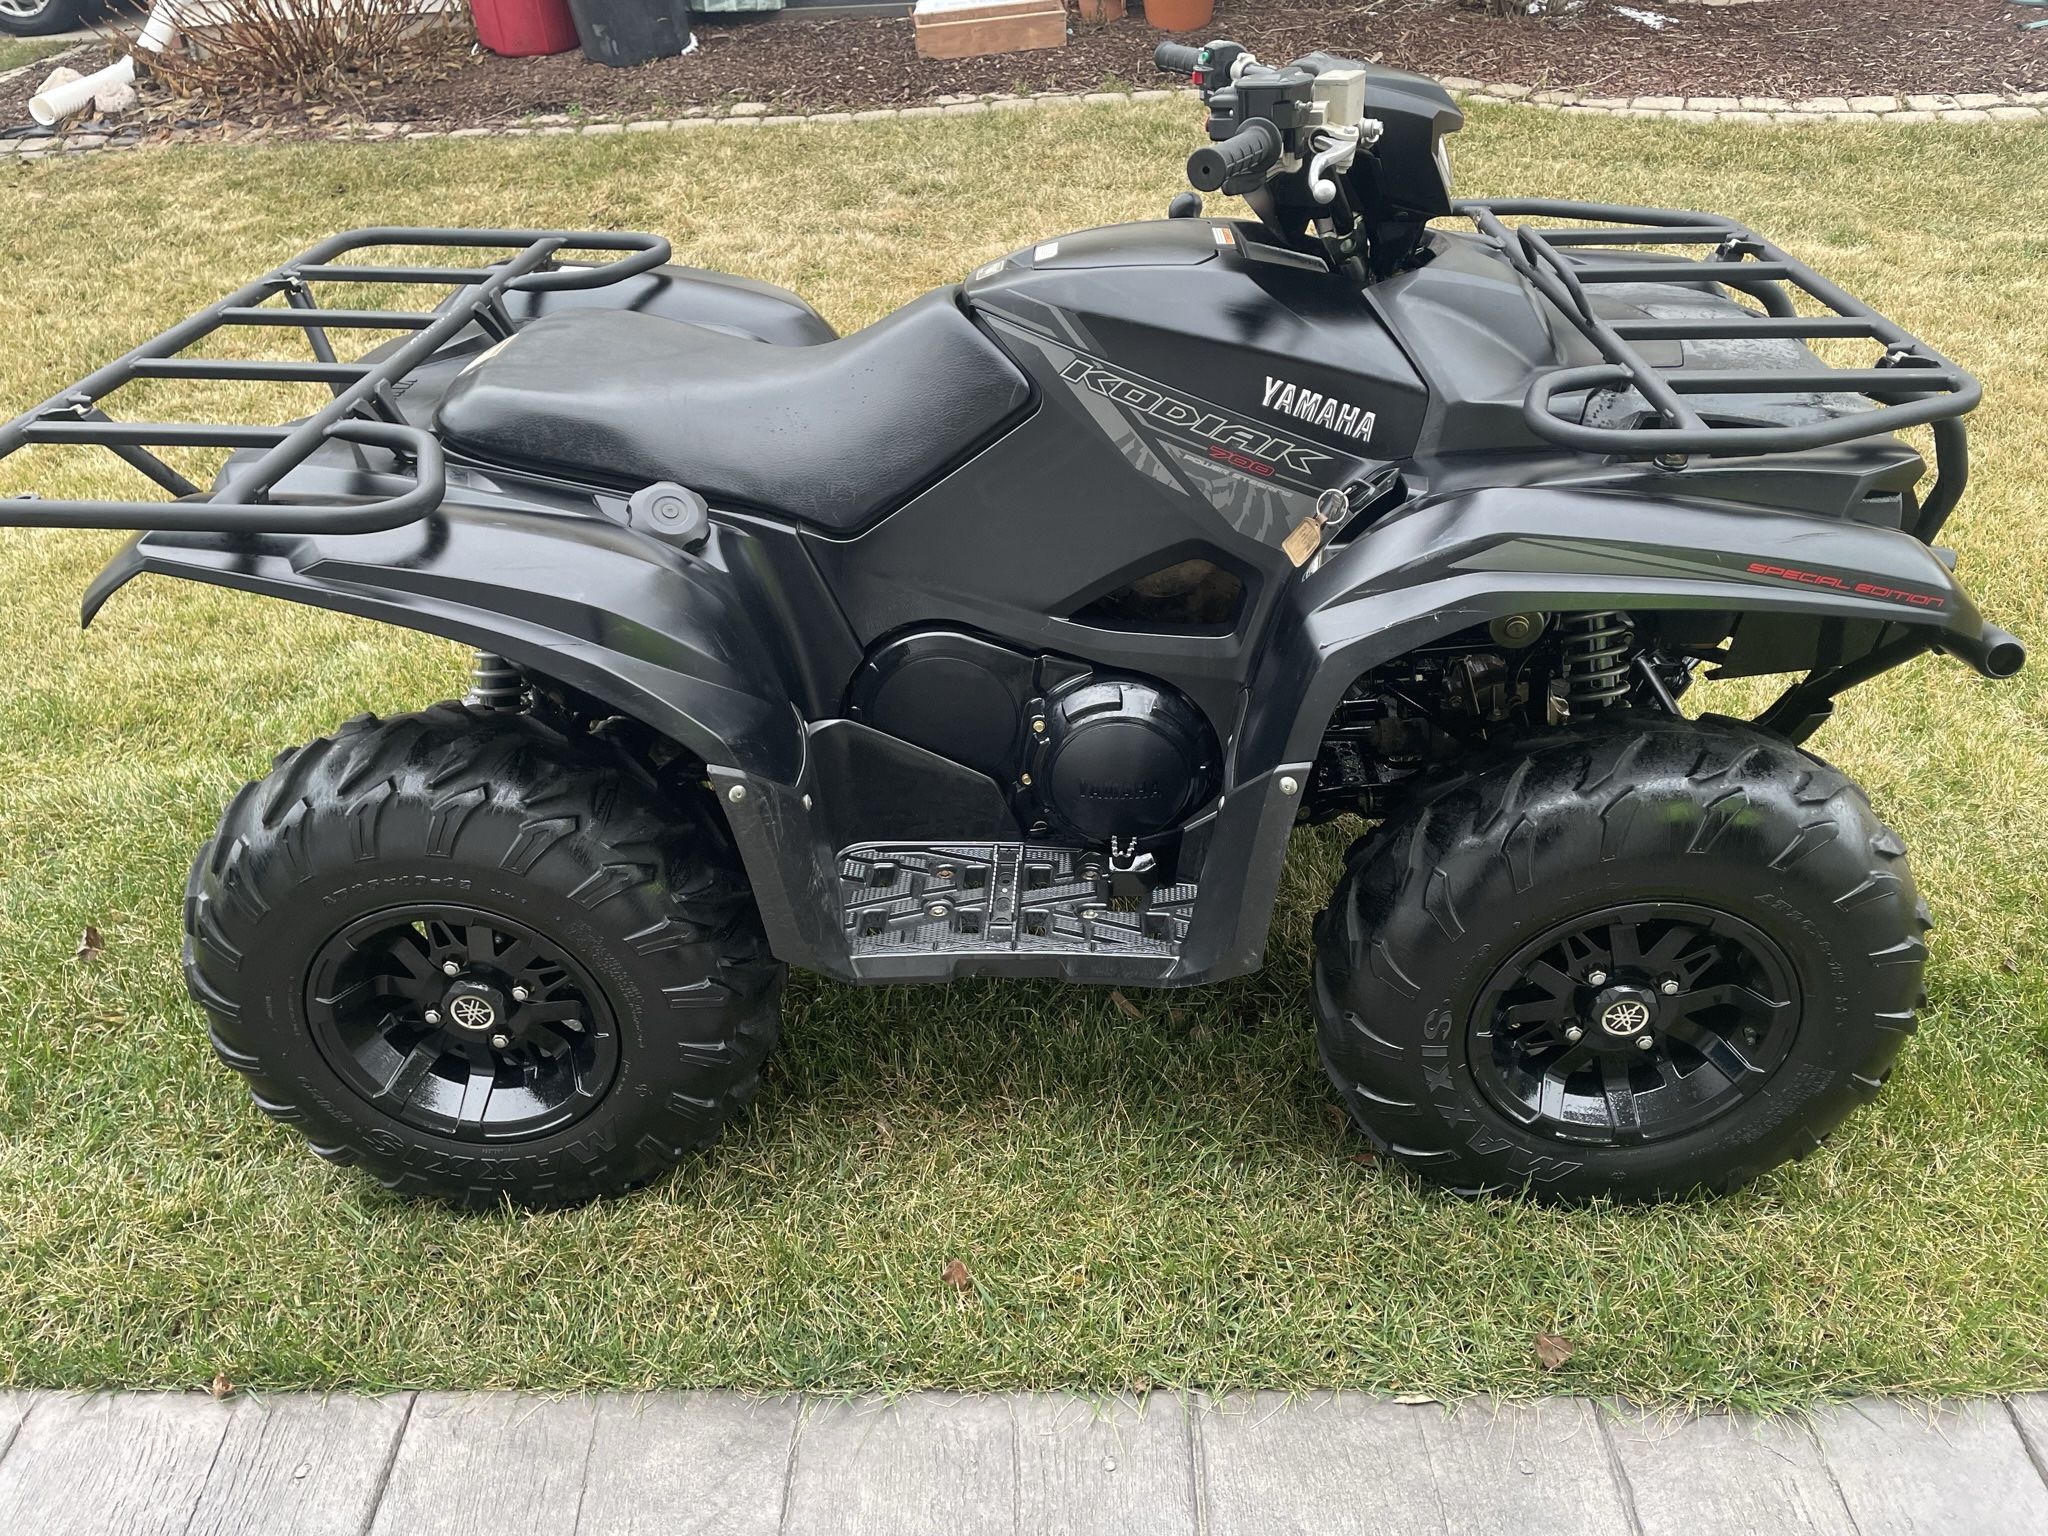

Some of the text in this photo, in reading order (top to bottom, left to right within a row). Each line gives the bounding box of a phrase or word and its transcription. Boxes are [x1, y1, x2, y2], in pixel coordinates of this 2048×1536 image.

[1060, 358, 1335, 475] KODIAK
[1262, 375, 1377, 443] YAMAHA
[1183, 454, 1294, 498] POWER STEERING
[1208, 445, 1276, 477] 700
[1746, 562, 1945, 608] SPECIAL EDITION
[1420, 1007, 1584, 1183] MAXXIS
